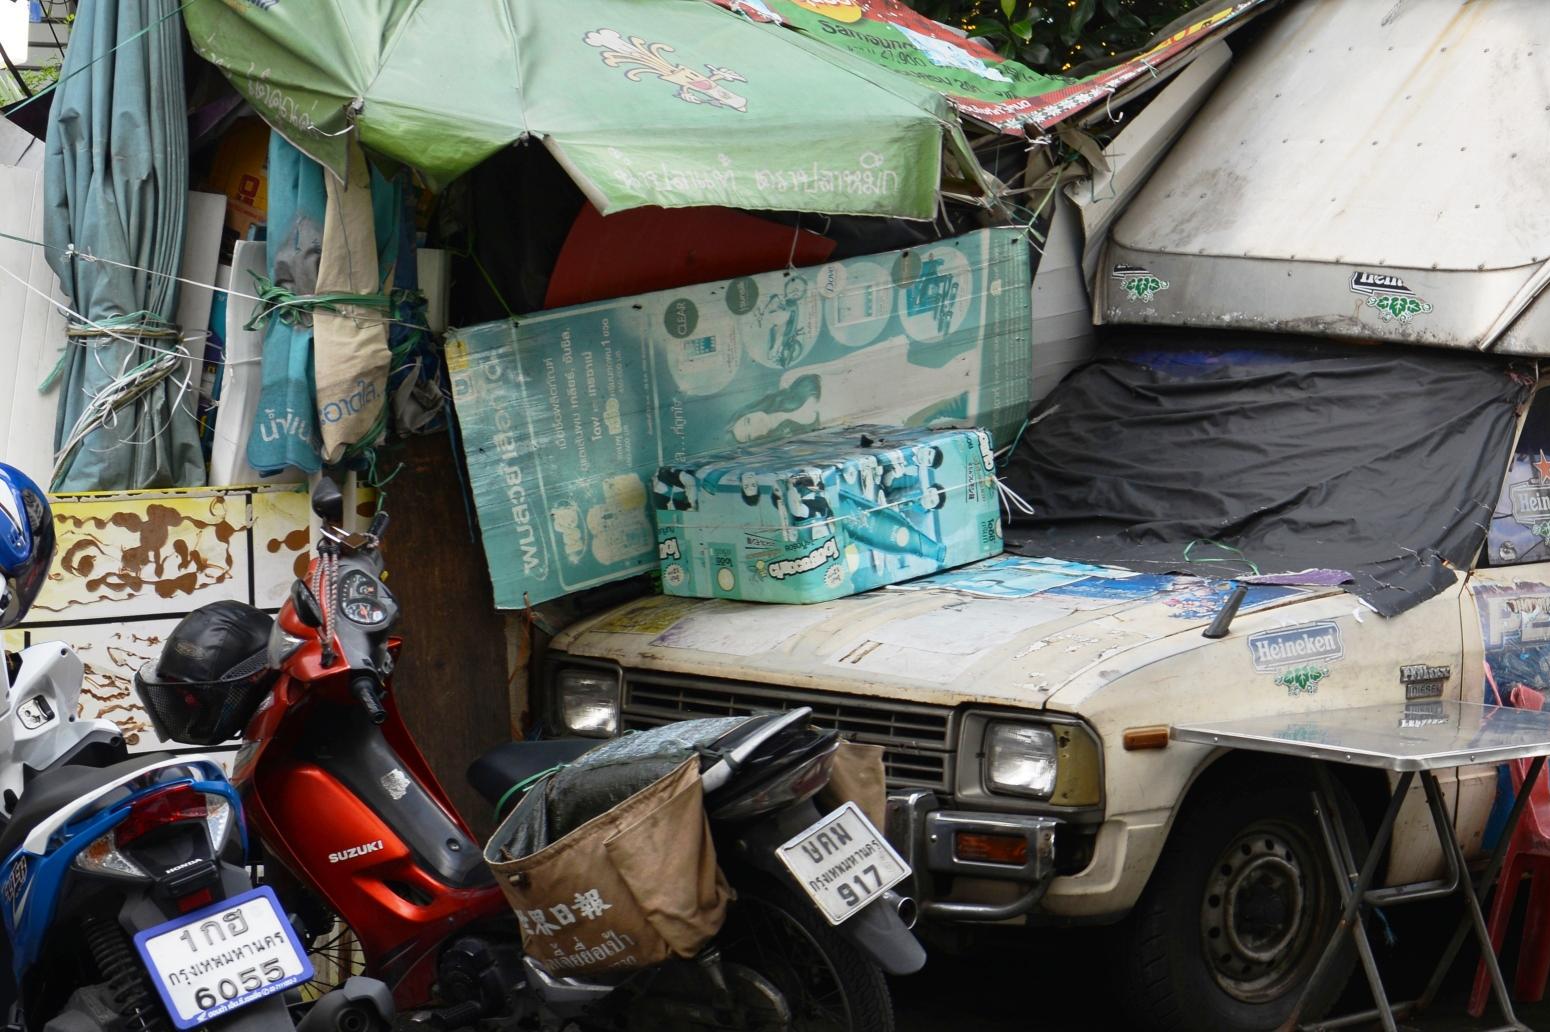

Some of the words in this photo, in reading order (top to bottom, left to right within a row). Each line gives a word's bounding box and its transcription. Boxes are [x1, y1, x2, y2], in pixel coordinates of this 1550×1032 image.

[675, 301, 688, 336] CLEAR
[1255, 634, 1337, 662] Heineken
[165, 859, 203, 874] HONDA
[328, 840, 384, 863] SUZUKI
[809, 840, 881, 892] กรุงเทพมหานคร
[837, 864, 883, 907] 917
[168, 931, 285, 987] กรุงเทพมหานคร
[194, 957, 285, 1011] 6055
